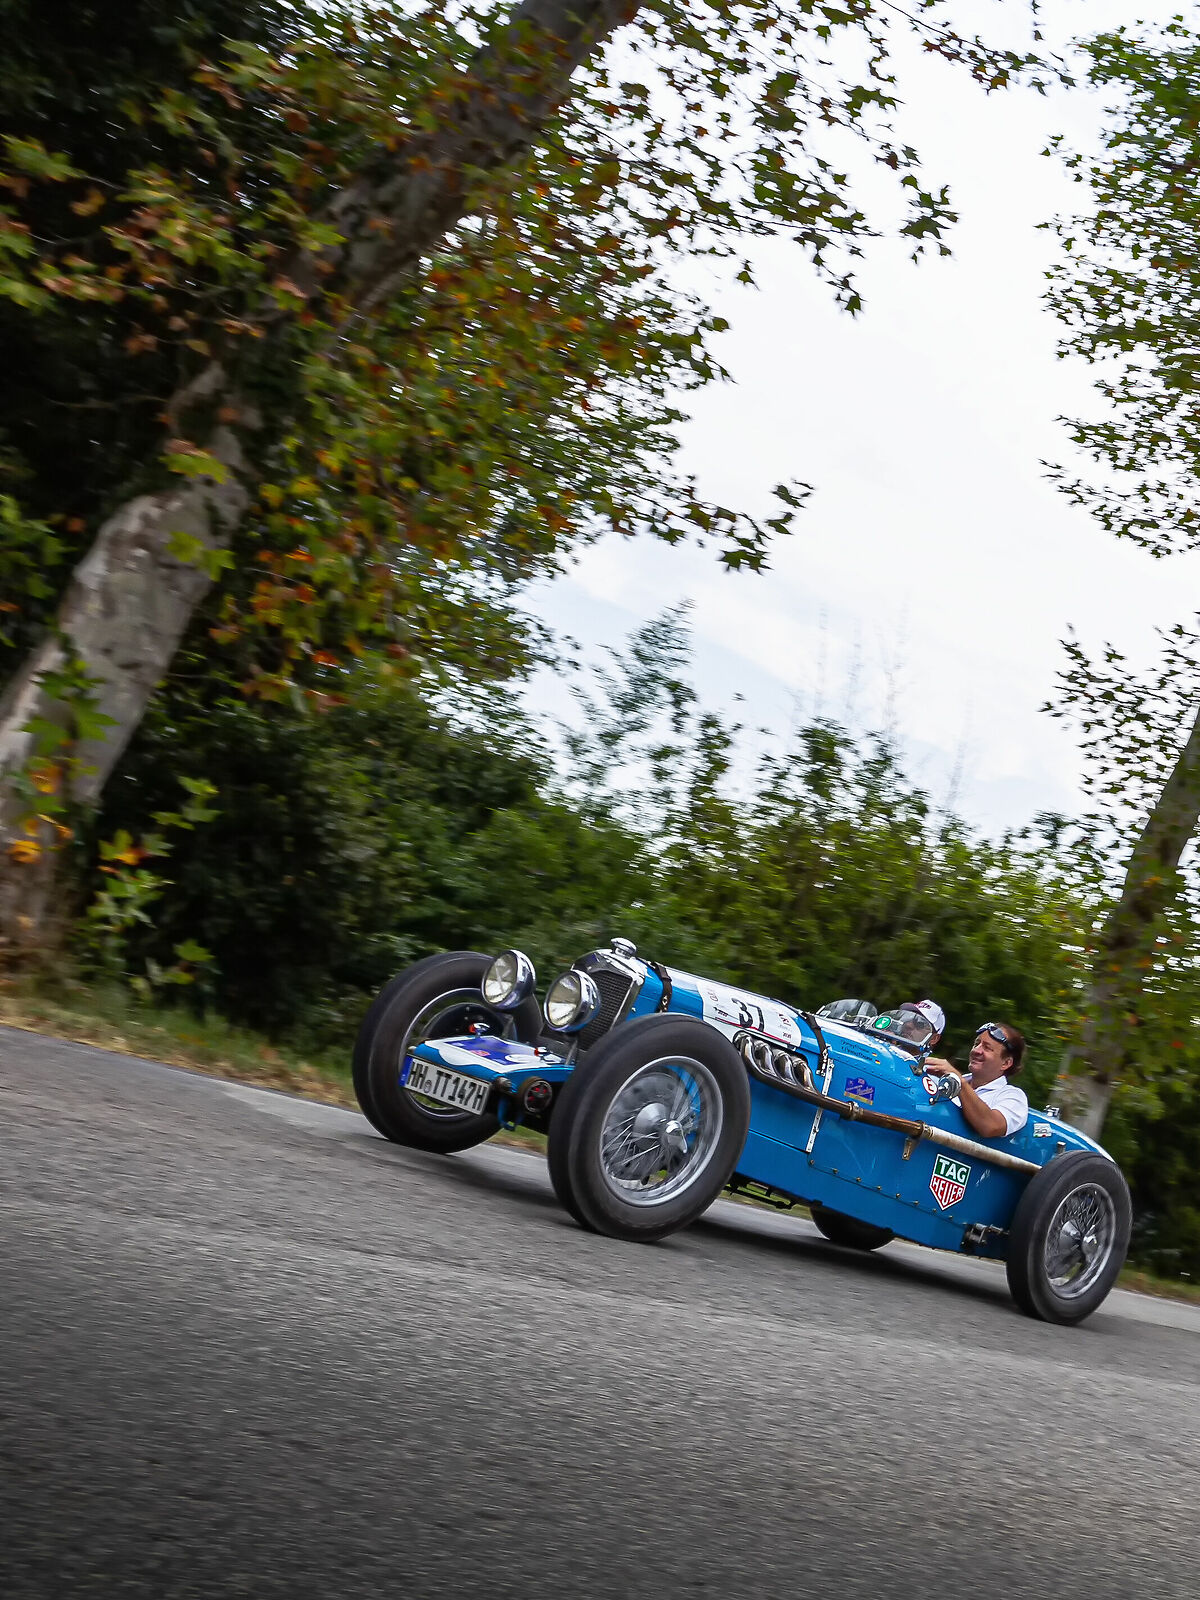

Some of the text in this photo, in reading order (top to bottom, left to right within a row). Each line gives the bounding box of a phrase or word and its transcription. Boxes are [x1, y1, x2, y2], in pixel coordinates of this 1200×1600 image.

[731, 997, 765, 1032] 37
[407, 1061, 428, 1089] HH
[939, 1158, 968, 1184] TAG
[932, 1177, 964, 1206] HEUER
